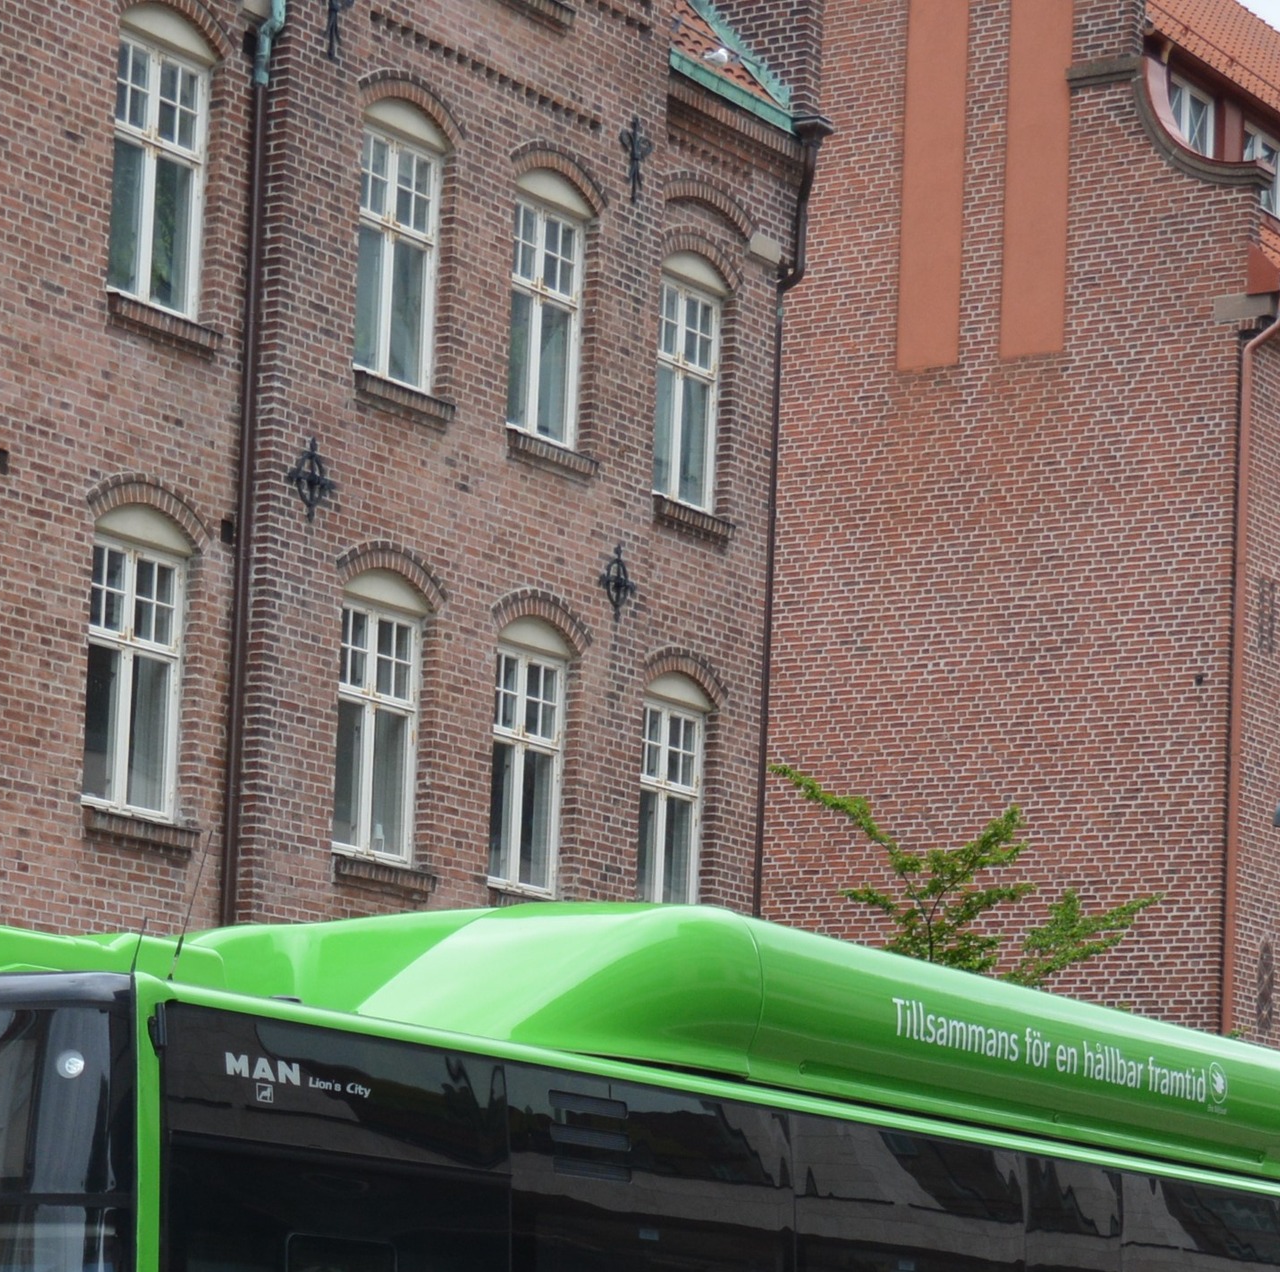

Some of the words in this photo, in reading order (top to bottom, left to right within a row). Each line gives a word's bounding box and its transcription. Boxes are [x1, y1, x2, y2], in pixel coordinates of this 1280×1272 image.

[224, 1051, 301, 1086] MAN
[308, 1075, 342, 1093] Lion's
[346, 1082, 372, 1099] City
[891, 996, 1019, 1063] Tillsammans
[1025, 1027, 1050, 1070] för
[1056, 1044, 1079, 1076] en
[1083, 1040, 1144, 1090] hållbar
[1147, 1055, 1207, 1104] framtid
